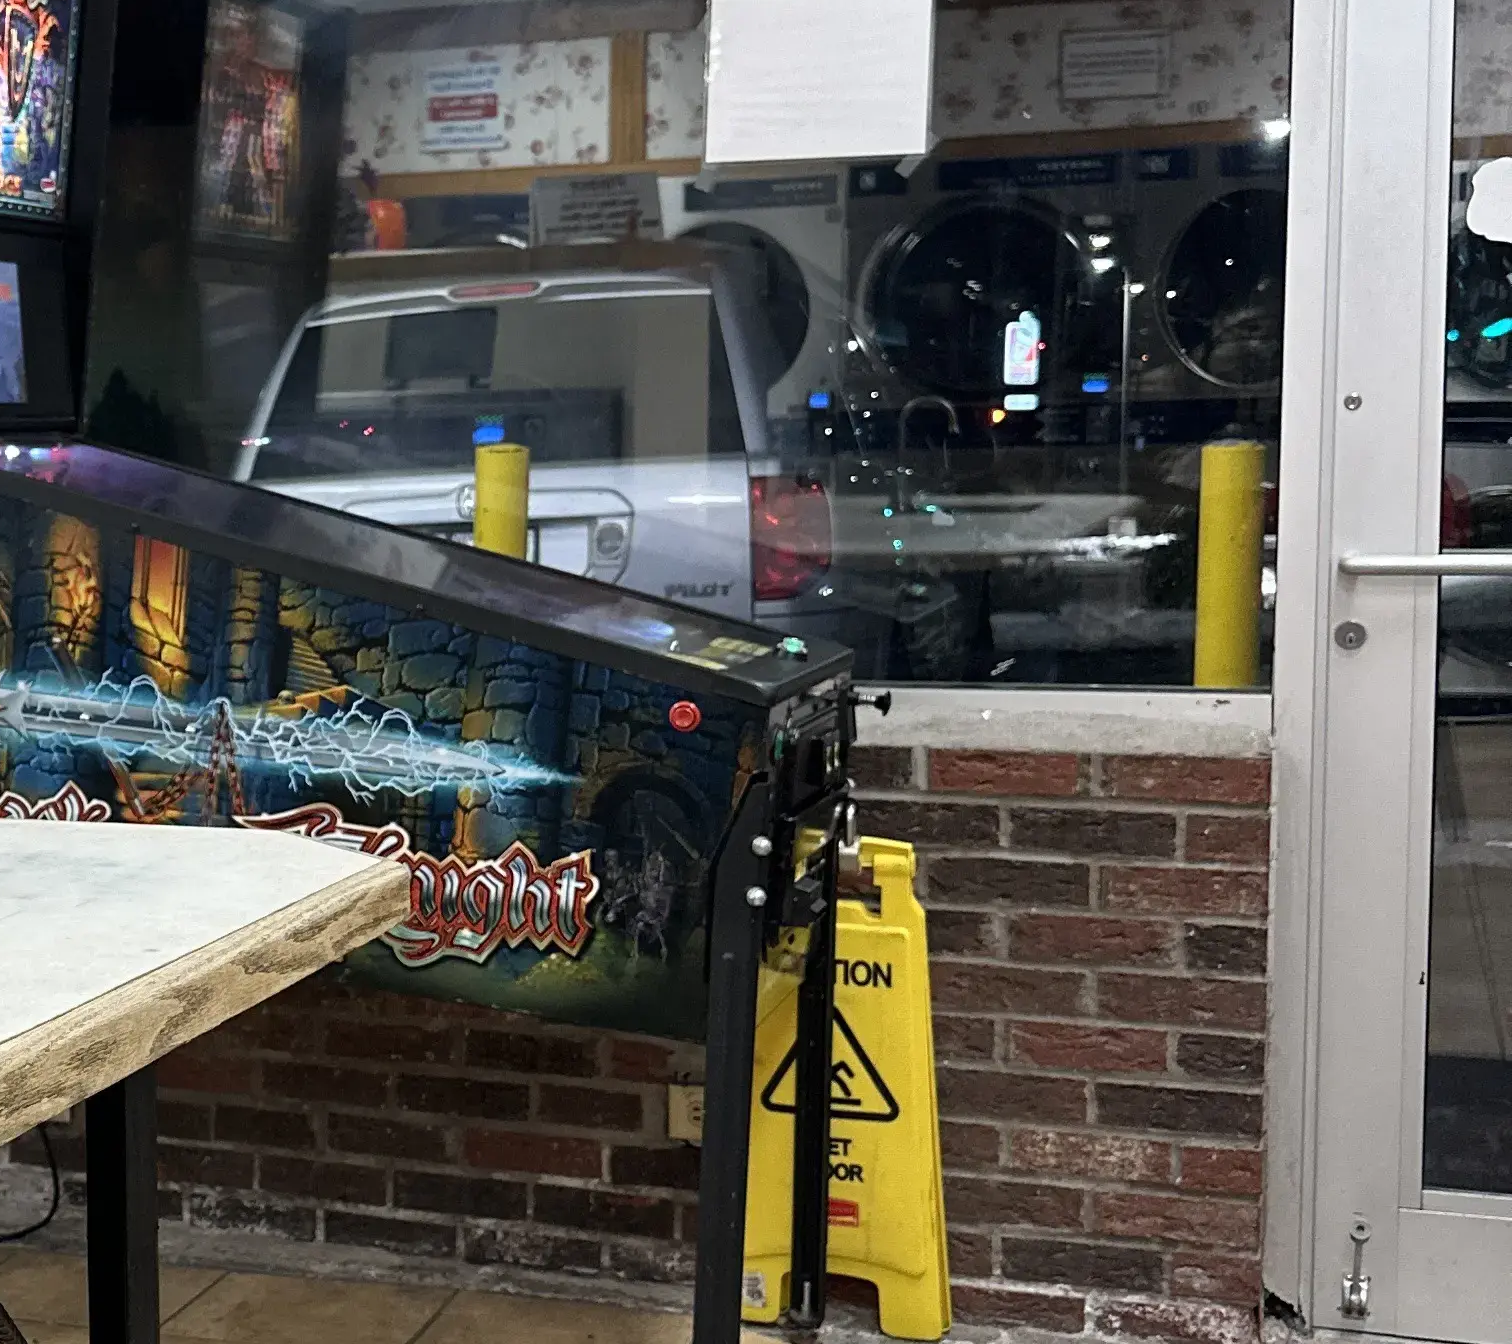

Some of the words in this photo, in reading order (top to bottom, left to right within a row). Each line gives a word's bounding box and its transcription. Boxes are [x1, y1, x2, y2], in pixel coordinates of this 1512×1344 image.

[664, 581, 736, 598] PILOT
[834, 958, 893, 989] TION
[828, 1137, 852, 1156] ET
